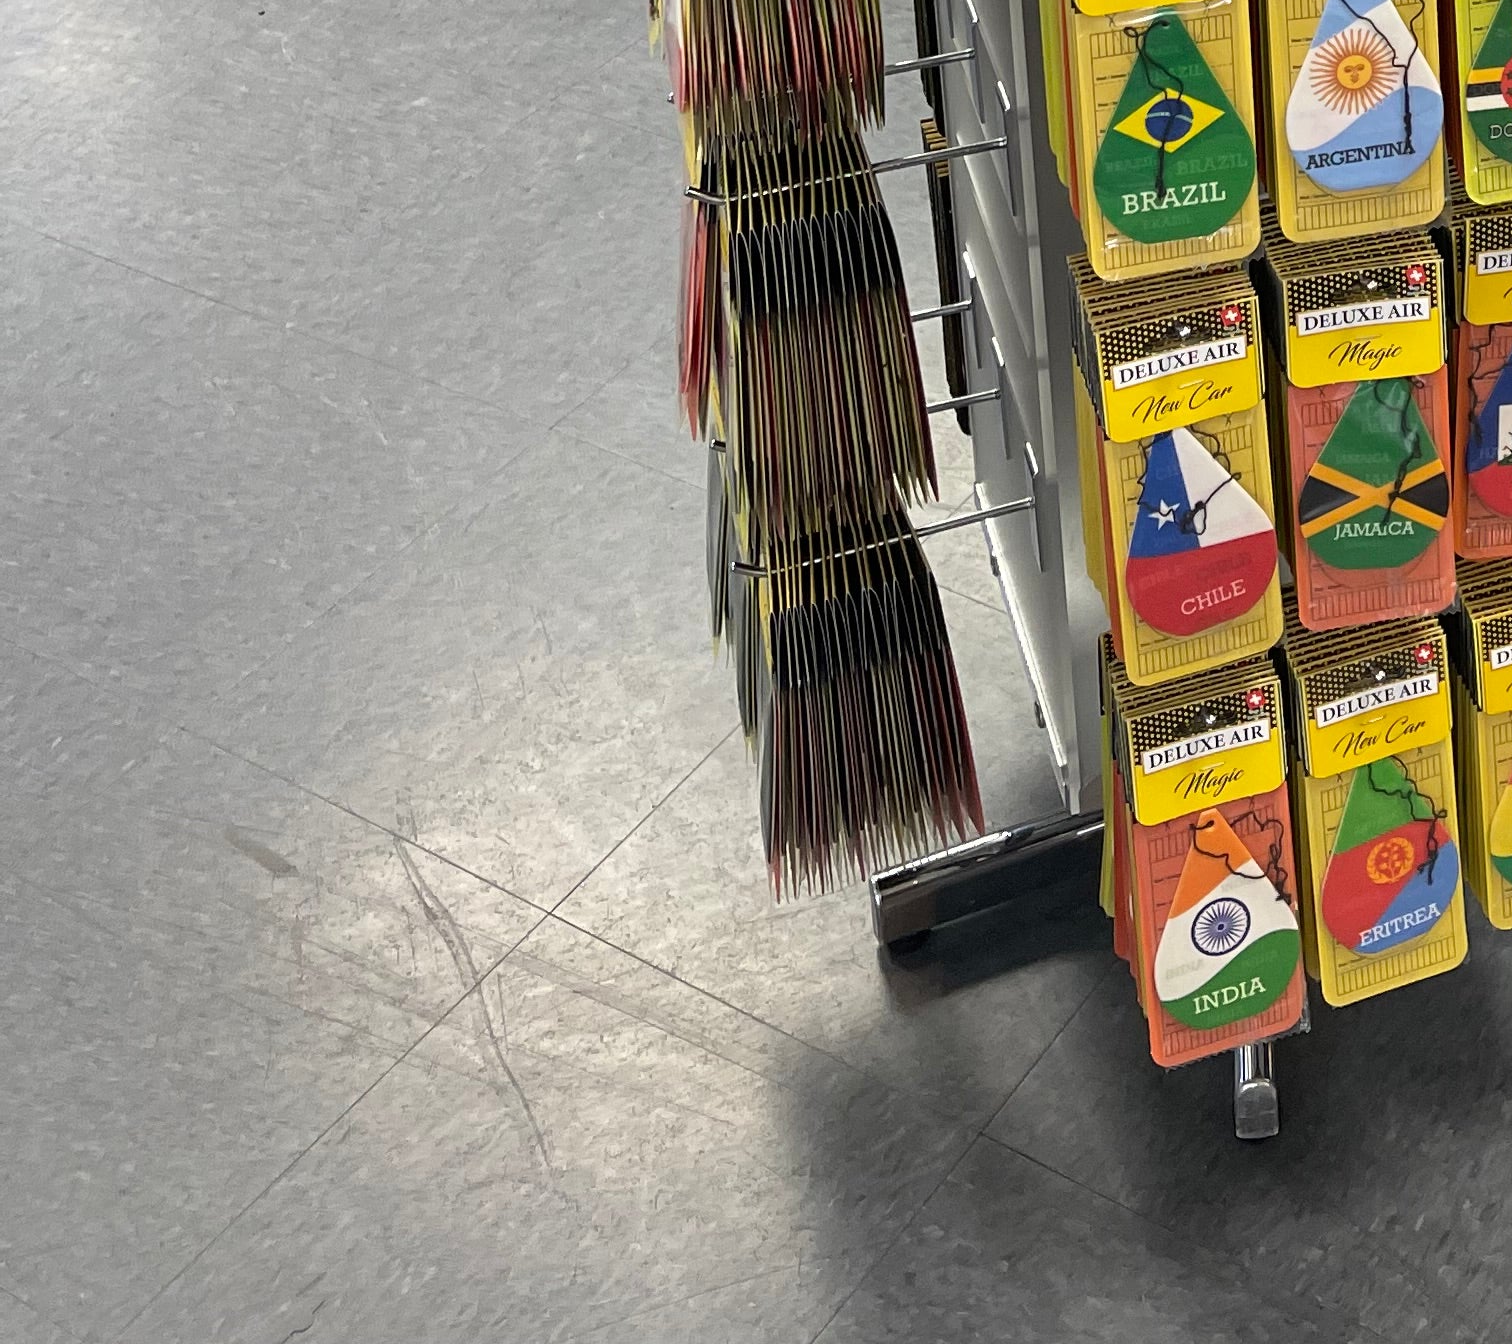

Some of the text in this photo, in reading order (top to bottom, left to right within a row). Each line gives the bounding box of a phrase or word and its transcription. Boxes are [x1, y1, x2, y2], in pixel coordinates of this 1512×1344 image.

[1304, 140, 1416, 172] ARGENTINA
[1121, 182, 1227, 216] BRAZIL
[1303, 300, 1425, 333] DELUXE AIR
[1119, 339, 1241, 385] DELUXE AIR
[1328, 343, 1403, 370] Magic
[1133, 384, 1233, 424] New Car
[1333, 519, 1415, 541] JAMAICA
[1180, 578, 1247, 616] CHILE
[1322, 678, 1433, 724] DELUXE AIR
[1148, 725, 1265, 771] DELUXE AIR
[1334, 717, 1427, 758] New Car
[1174, 767, 1245, 800] Magic
[1358, 903, 1442, 948] ERITREA
[1193, 976, 1268, 1016] INDIA
